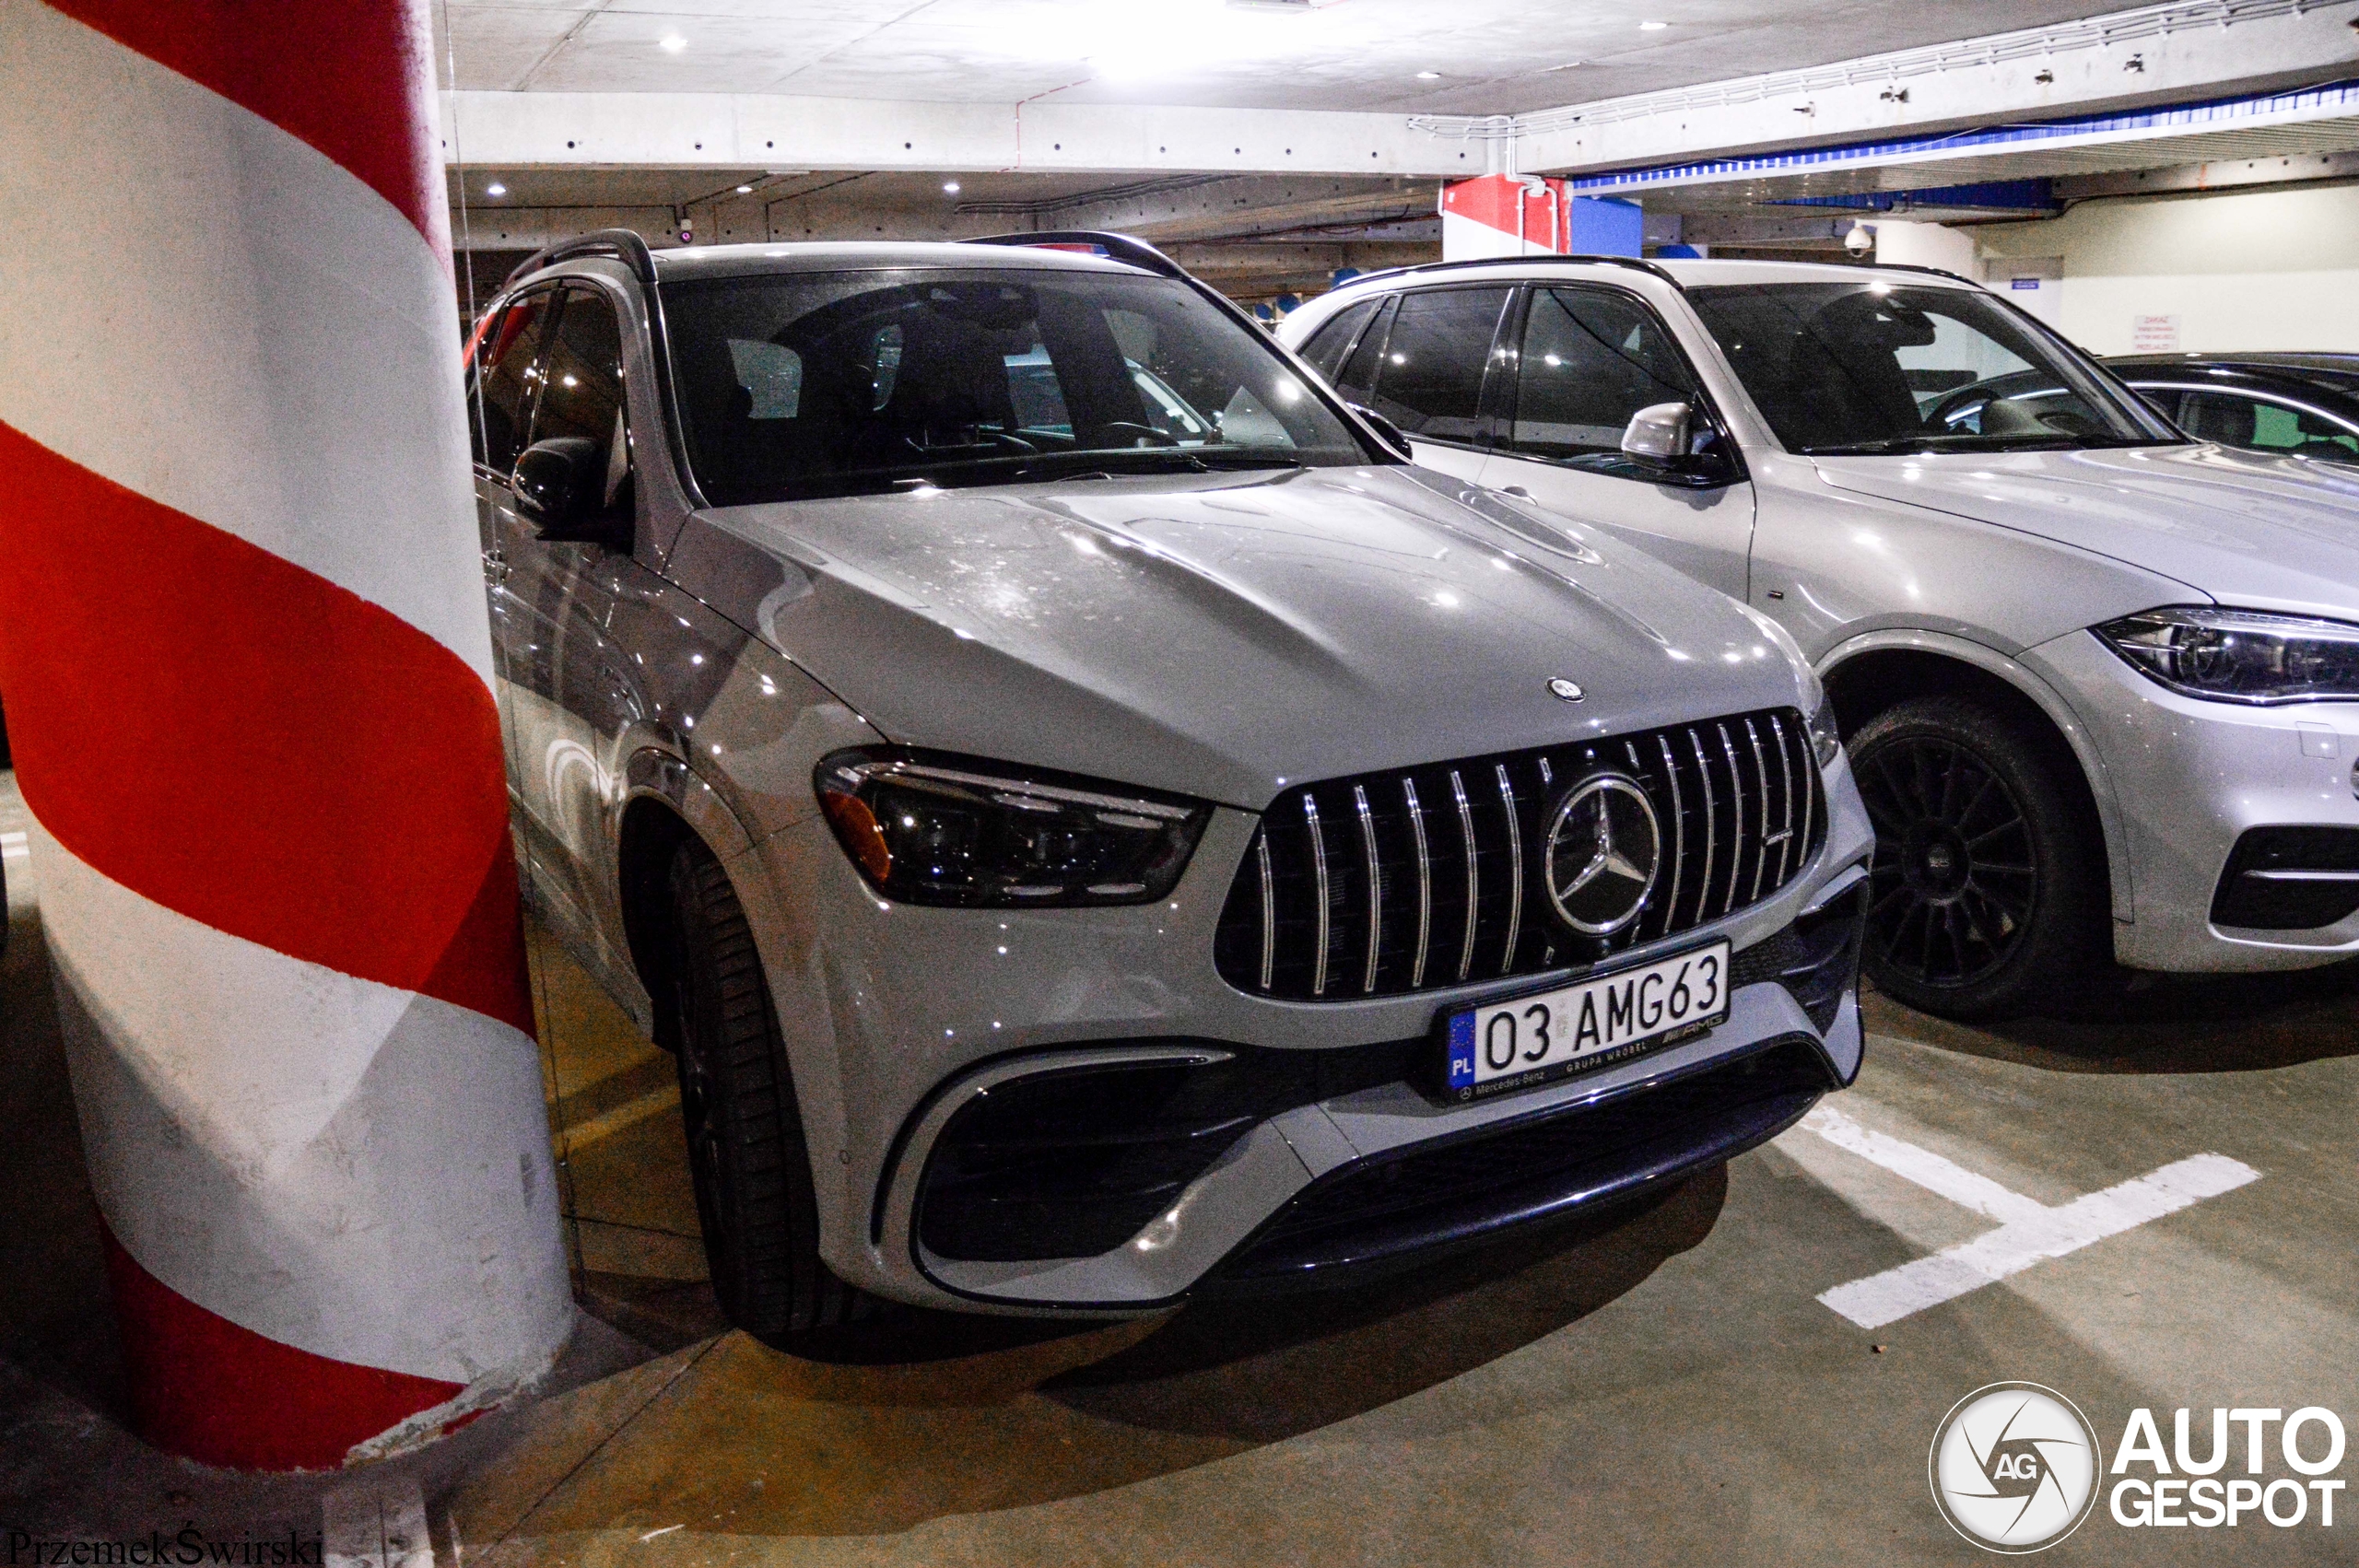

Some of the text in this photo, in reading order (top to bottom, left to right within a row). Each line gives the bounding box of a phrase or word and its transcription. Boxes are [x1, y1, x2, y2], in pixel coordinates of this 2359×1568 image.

[1572, 954, 1719, 1052] AMG63
[1452, 1058, 1473, 1076] PL
[1566, 1056, 1602, 1073] GRUPA
[1475, 1071, 1544, 1095] Mercedes-Benz
